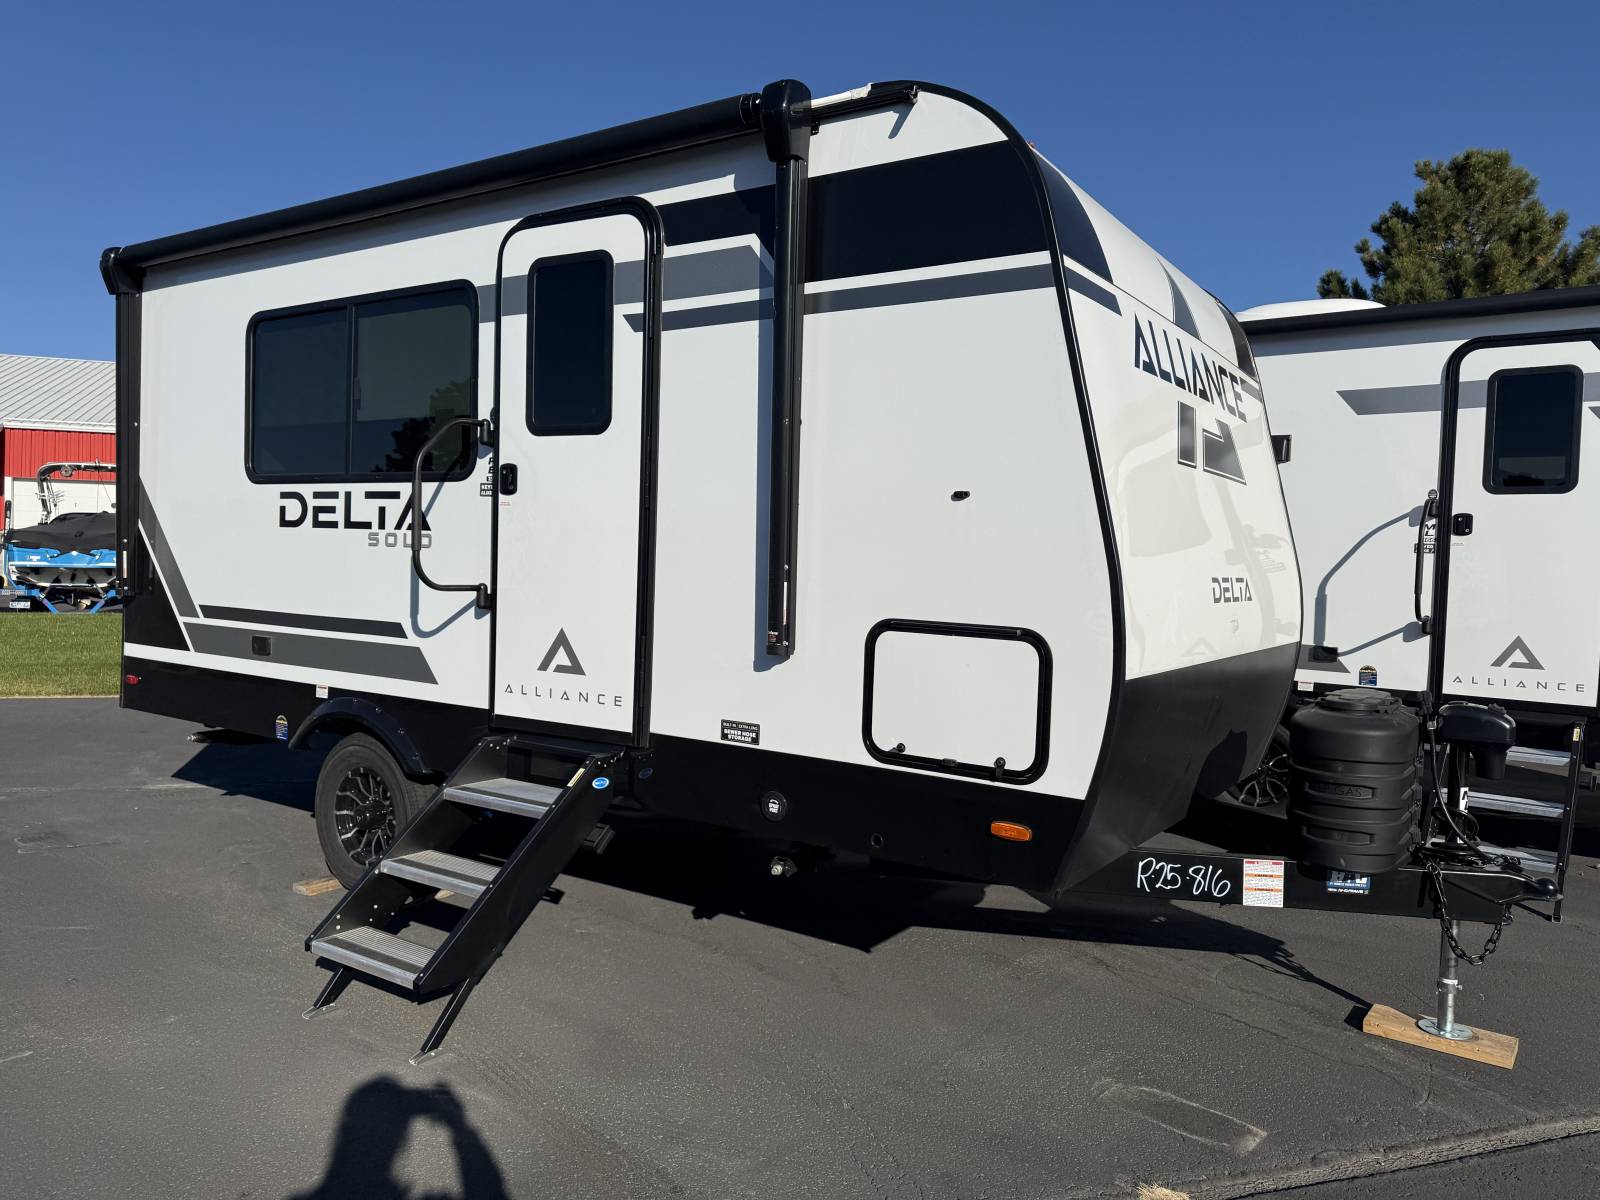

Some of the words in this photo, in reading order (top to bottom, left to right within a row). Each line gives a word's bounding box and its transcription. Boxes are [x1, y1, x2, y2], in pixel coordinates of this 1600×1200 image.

[1134, 313, 1247, 423] ALLIANCE
[279, 491, 432, 531] DELTA
[1211, 577, 1253, 604] DELTA
[504, 683, 623, 707] ALLIANCE
[1452, 675, 1585, 693] ALLIANCE
